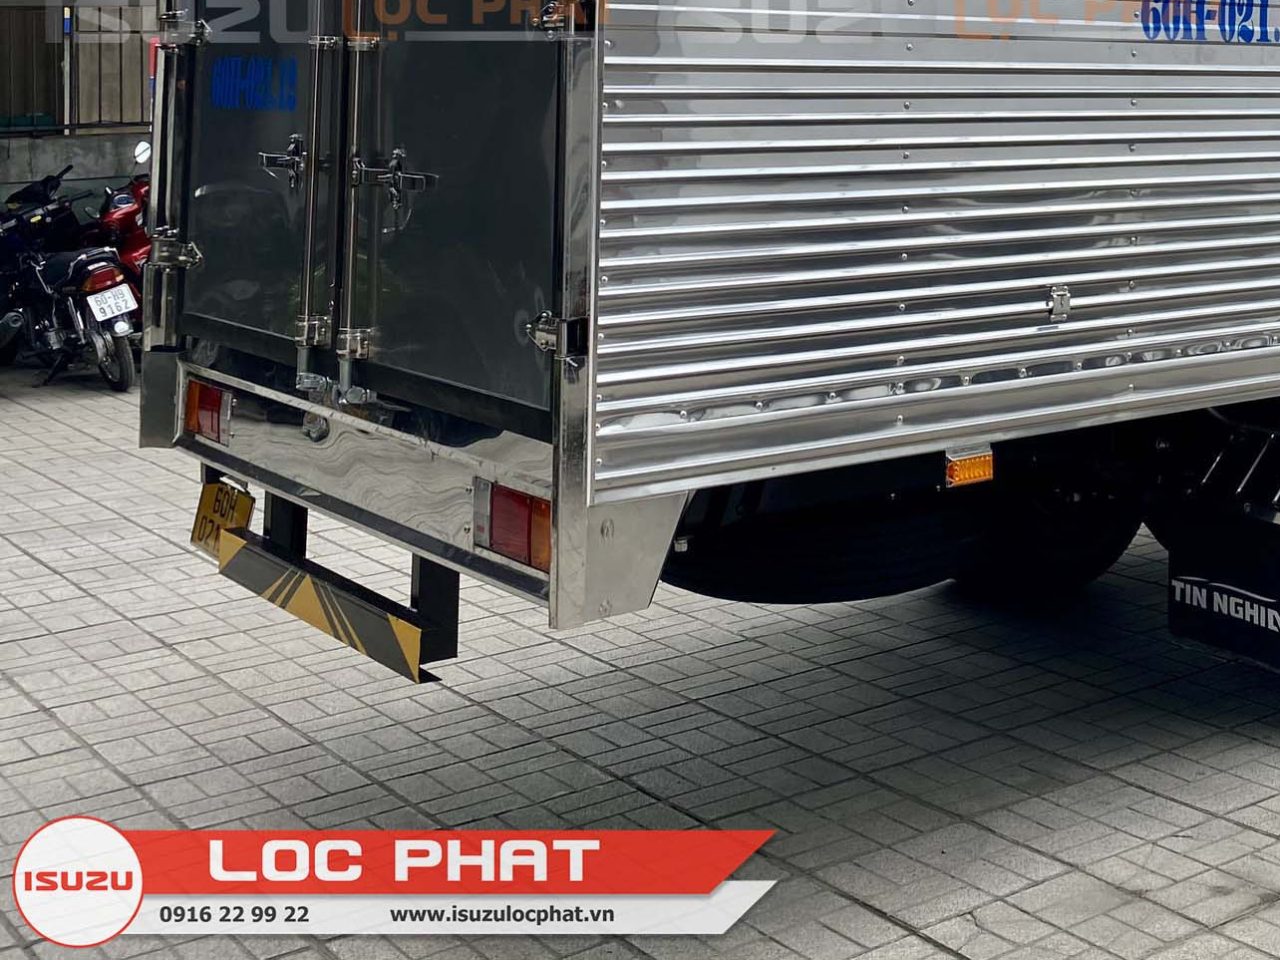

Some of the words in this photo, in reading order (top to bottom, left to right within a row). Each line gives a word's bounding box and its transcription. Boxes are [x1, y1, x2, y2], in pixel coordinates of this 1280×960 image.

[94, 288, 125, 307] 60-H9
[99, 299, 131, 317] 9162
[212, 485, 239, 523] 60H
[1171, 579, 1207, 609] TIN
